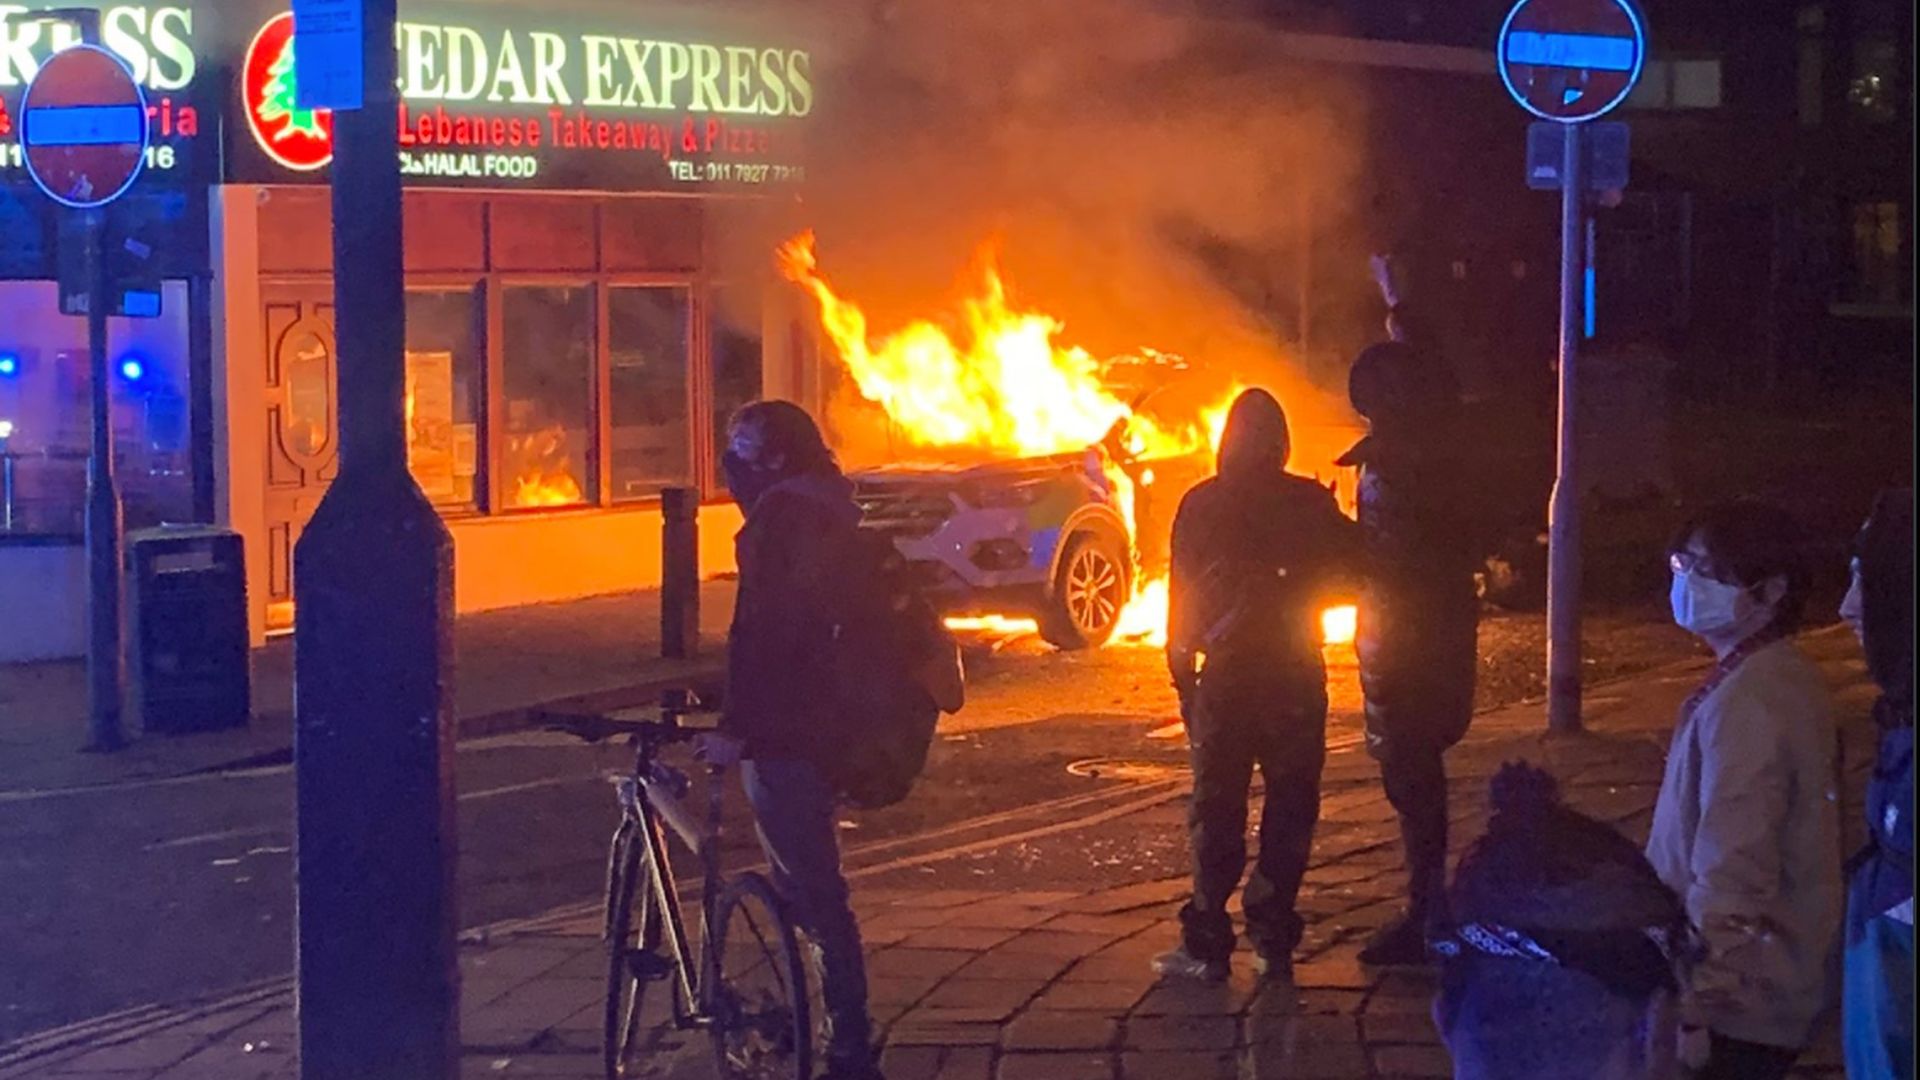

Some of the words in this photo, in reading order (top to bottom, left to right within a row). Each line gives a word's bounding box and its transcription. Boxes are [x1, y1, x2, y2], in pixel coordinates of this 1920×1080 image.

[396, 22, 573, 105] EDAR
[581, 35, 813, 117] EXPRESS
[398, 102, 541, 147] Lebanese
[547, 106, 673, 160] Takeaway
[682, 116, 698, 152] &
[424, 153, 481, 175] HALAL
[484, 154, 537, 178] FOOD
[668, 160, 704, 181] TEL:
